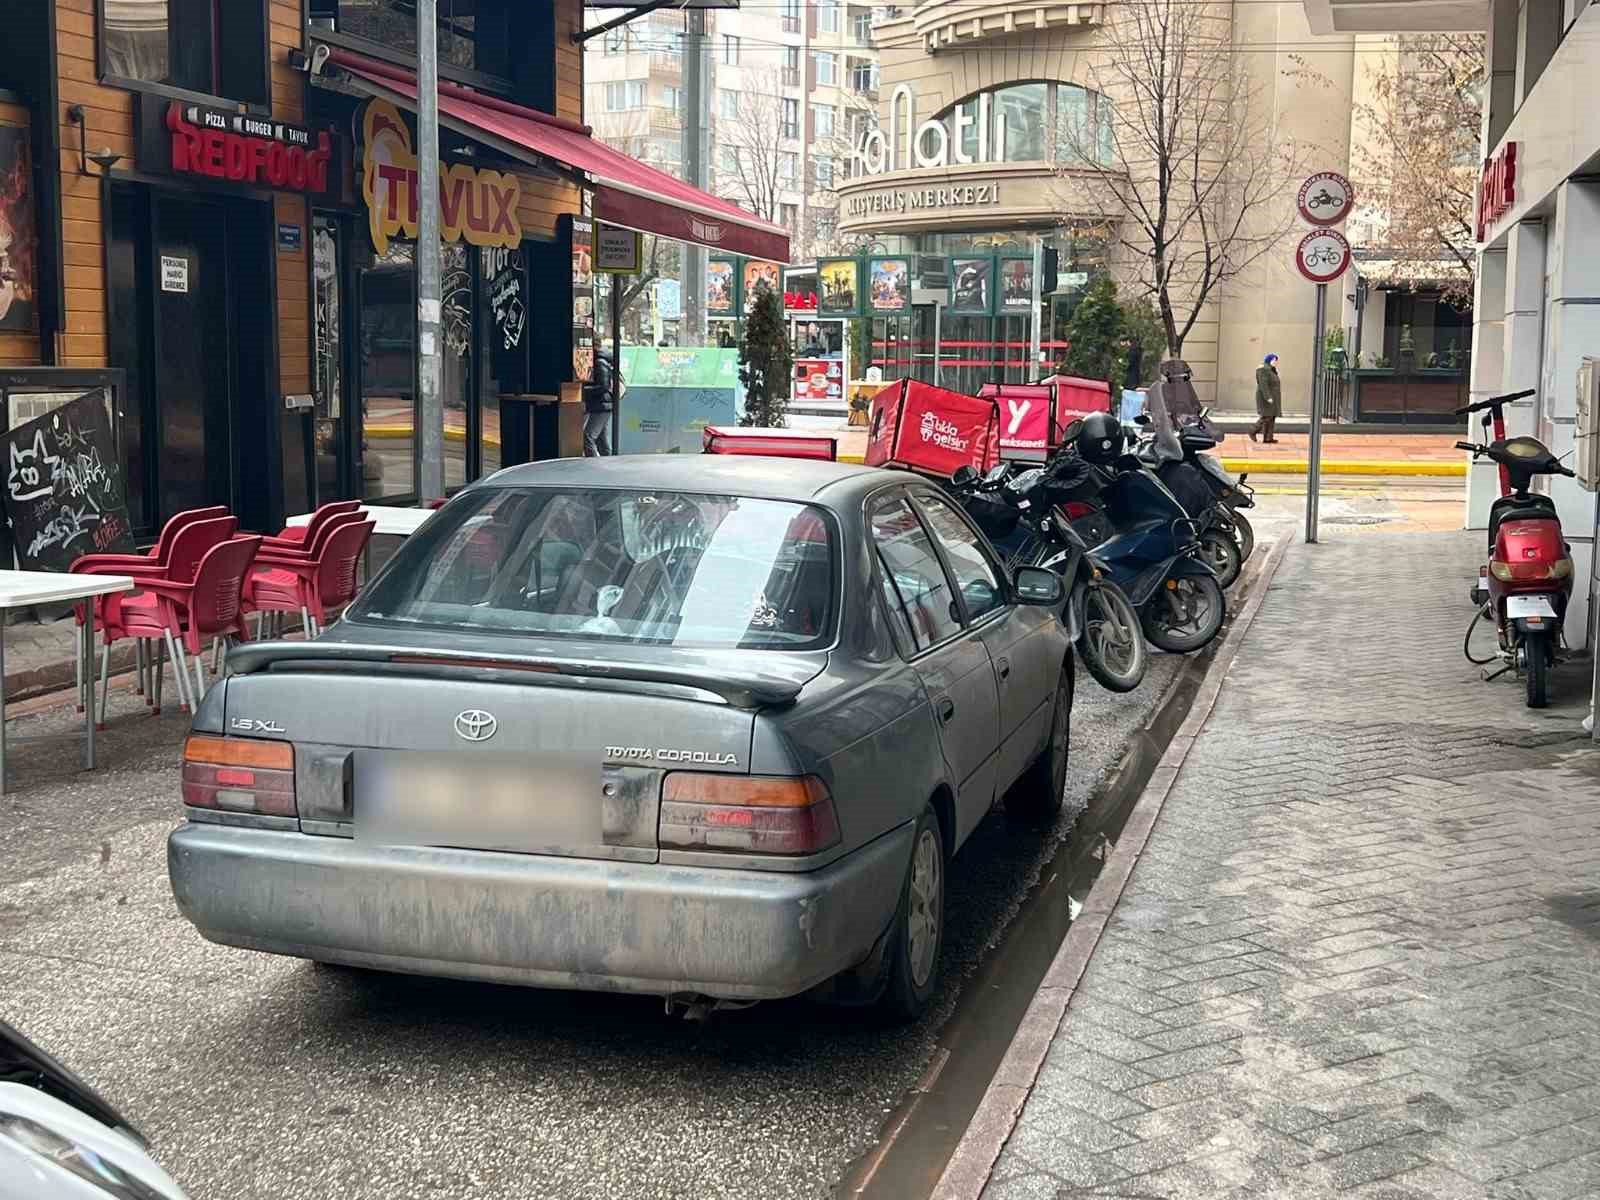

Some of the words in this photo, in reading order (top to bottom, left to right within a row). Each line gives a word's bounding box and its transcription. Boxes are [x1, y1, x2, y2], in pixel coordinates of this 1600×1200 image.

[245, 119, 272, 136] BURGER
[289, 128, 309, 145] TAVUK
[167, 110, 332, 192] REDFOOD
[910, 182, 1000, 209] MERKEZİ
[255, 719, 287, 732] XL
[604, 745, 654, 759] TOYOTA
[655, 748, 738, 765] COROLLA
